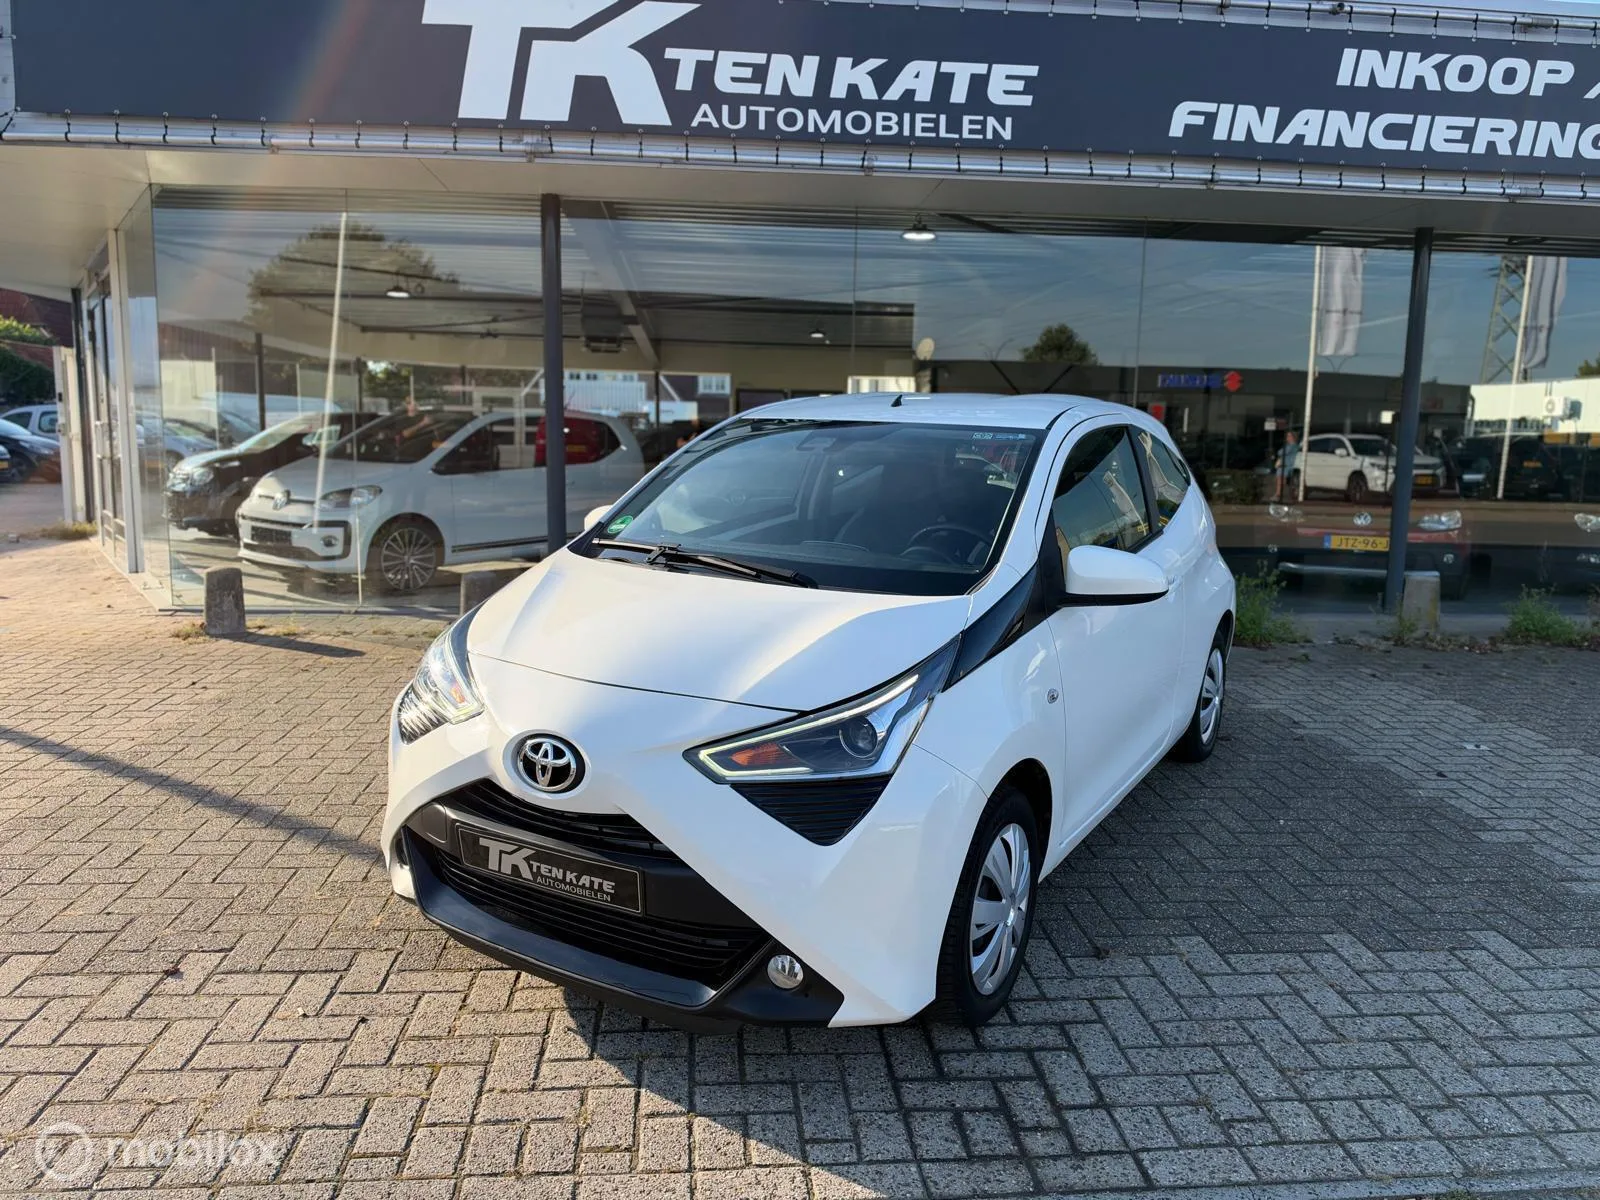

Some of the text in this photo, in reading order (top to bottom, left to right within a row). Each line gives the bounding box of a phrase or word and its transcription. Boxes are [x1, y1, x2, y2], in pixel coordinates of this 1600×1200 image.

[664, 48, 1039, 106] TEN KATE
[1337, 47, 1574, 96] INKOOP
[691, 103, 1012, 141] AUTOMOBIELEN
[479, 838, 536, 881] TK
[530, 861, 616, 894] TEN KATE
[536, 875, 611, 902] AUTOMOBIELEN
